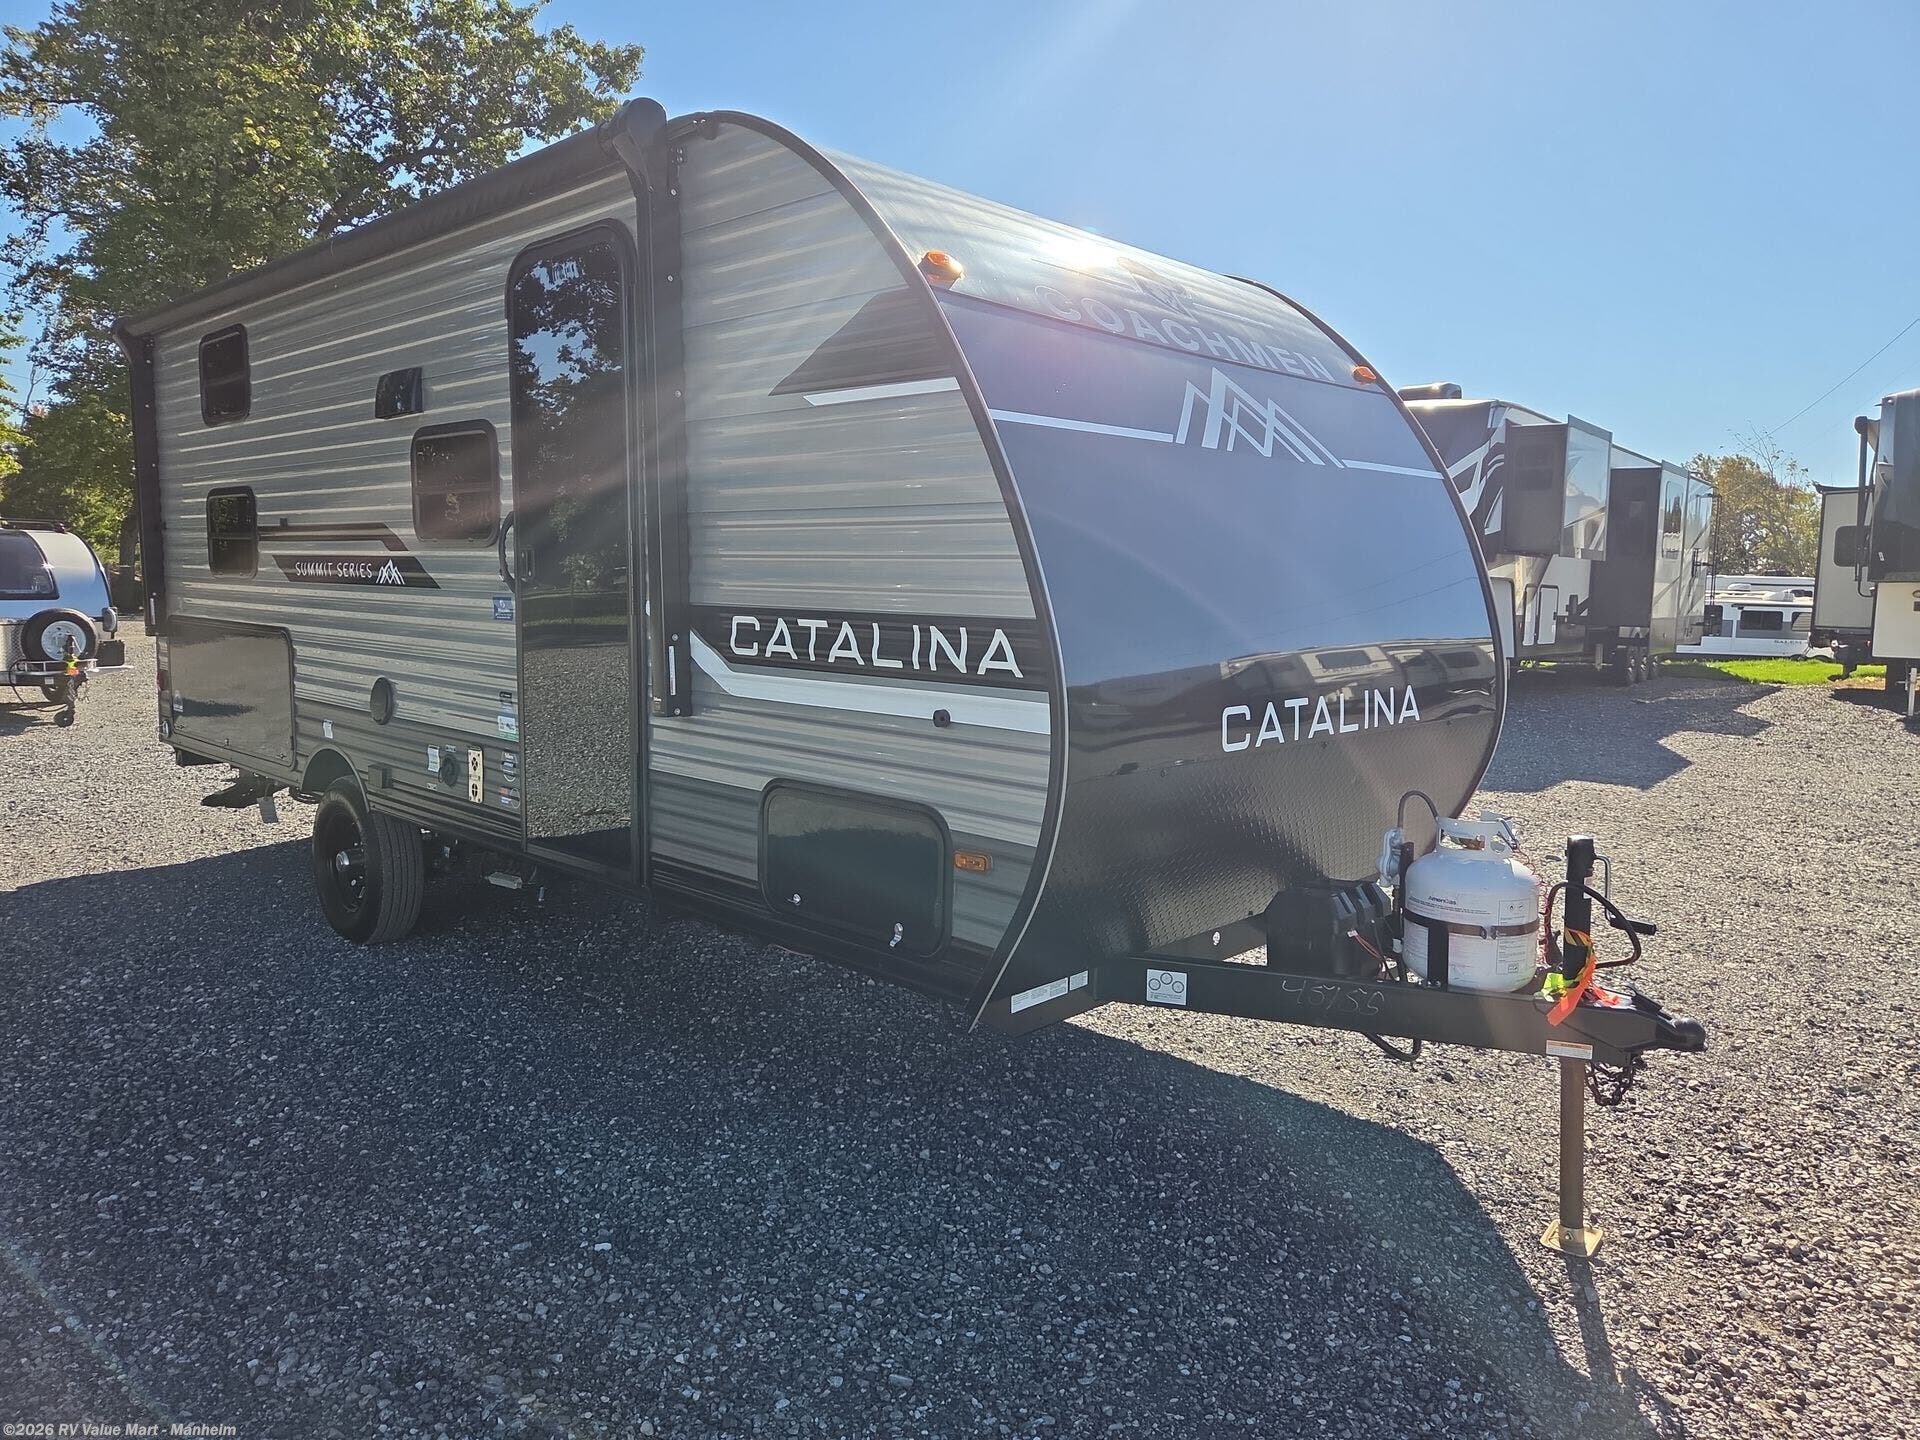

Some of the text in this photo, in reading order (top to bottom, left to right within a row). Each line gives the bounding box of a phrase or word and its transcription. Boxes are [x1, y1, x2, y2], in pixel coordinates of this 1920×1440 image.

[1034, 285, 1336, 382] COACHMEN
[295, 561, 373, 579] SUMMIT SERIES
[729, 615, 1024, 679] CATALINA
[1221, 684, 1421, 753] CATALINA
